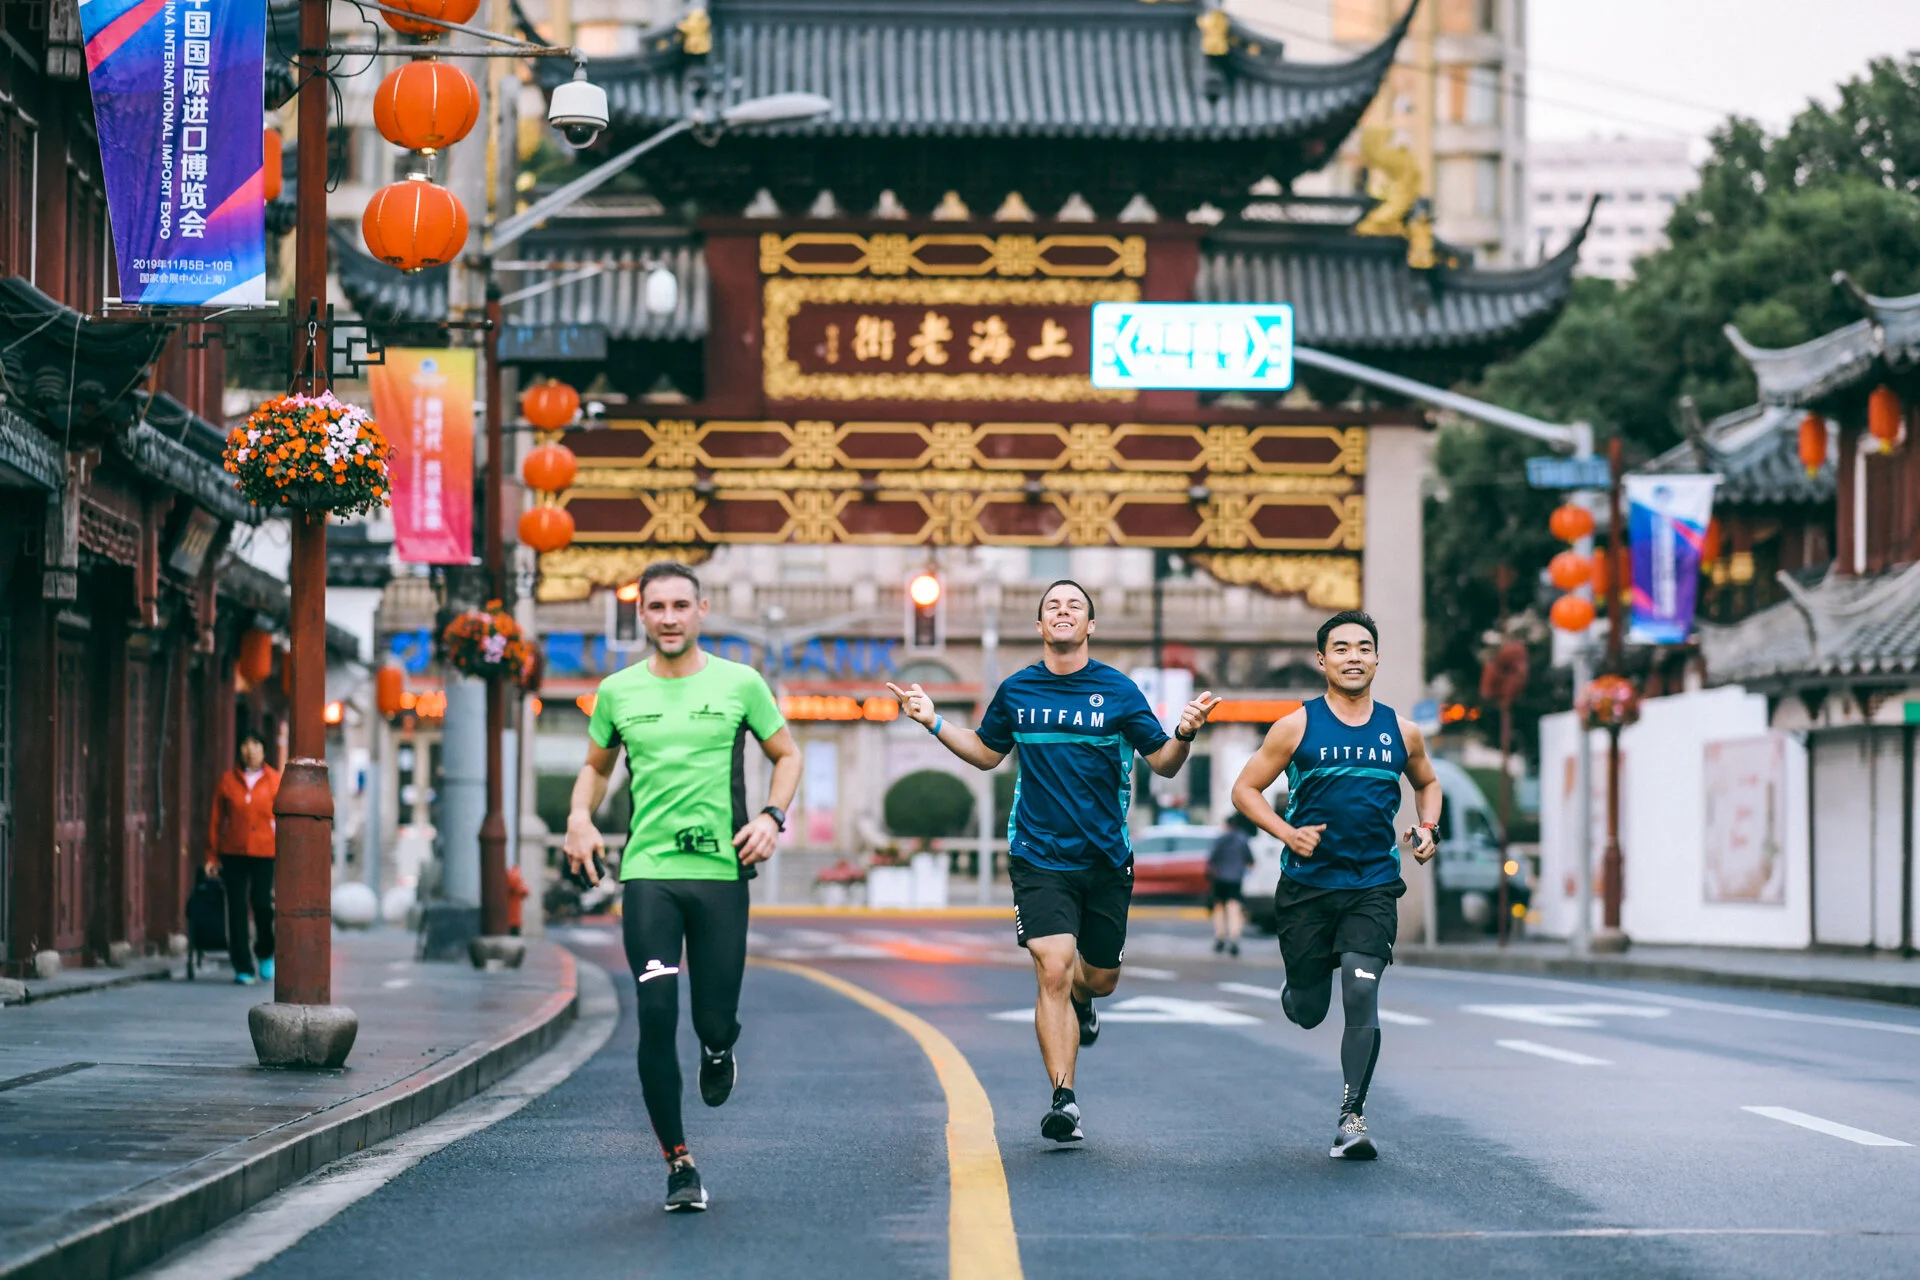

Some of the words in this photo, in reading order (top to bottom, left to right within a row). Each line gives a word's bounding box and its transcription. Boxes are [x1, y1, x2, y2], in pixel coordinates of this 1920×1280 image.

[162, 29, 176, 140] INTERNATIONAL
[161, 144, 174, 197] IMPORT
[160, 201, 171, 240] EXPO
[1017, 708, 1105, 728] FITFAM
[1320, 746, 1392, 763] FITFAM
